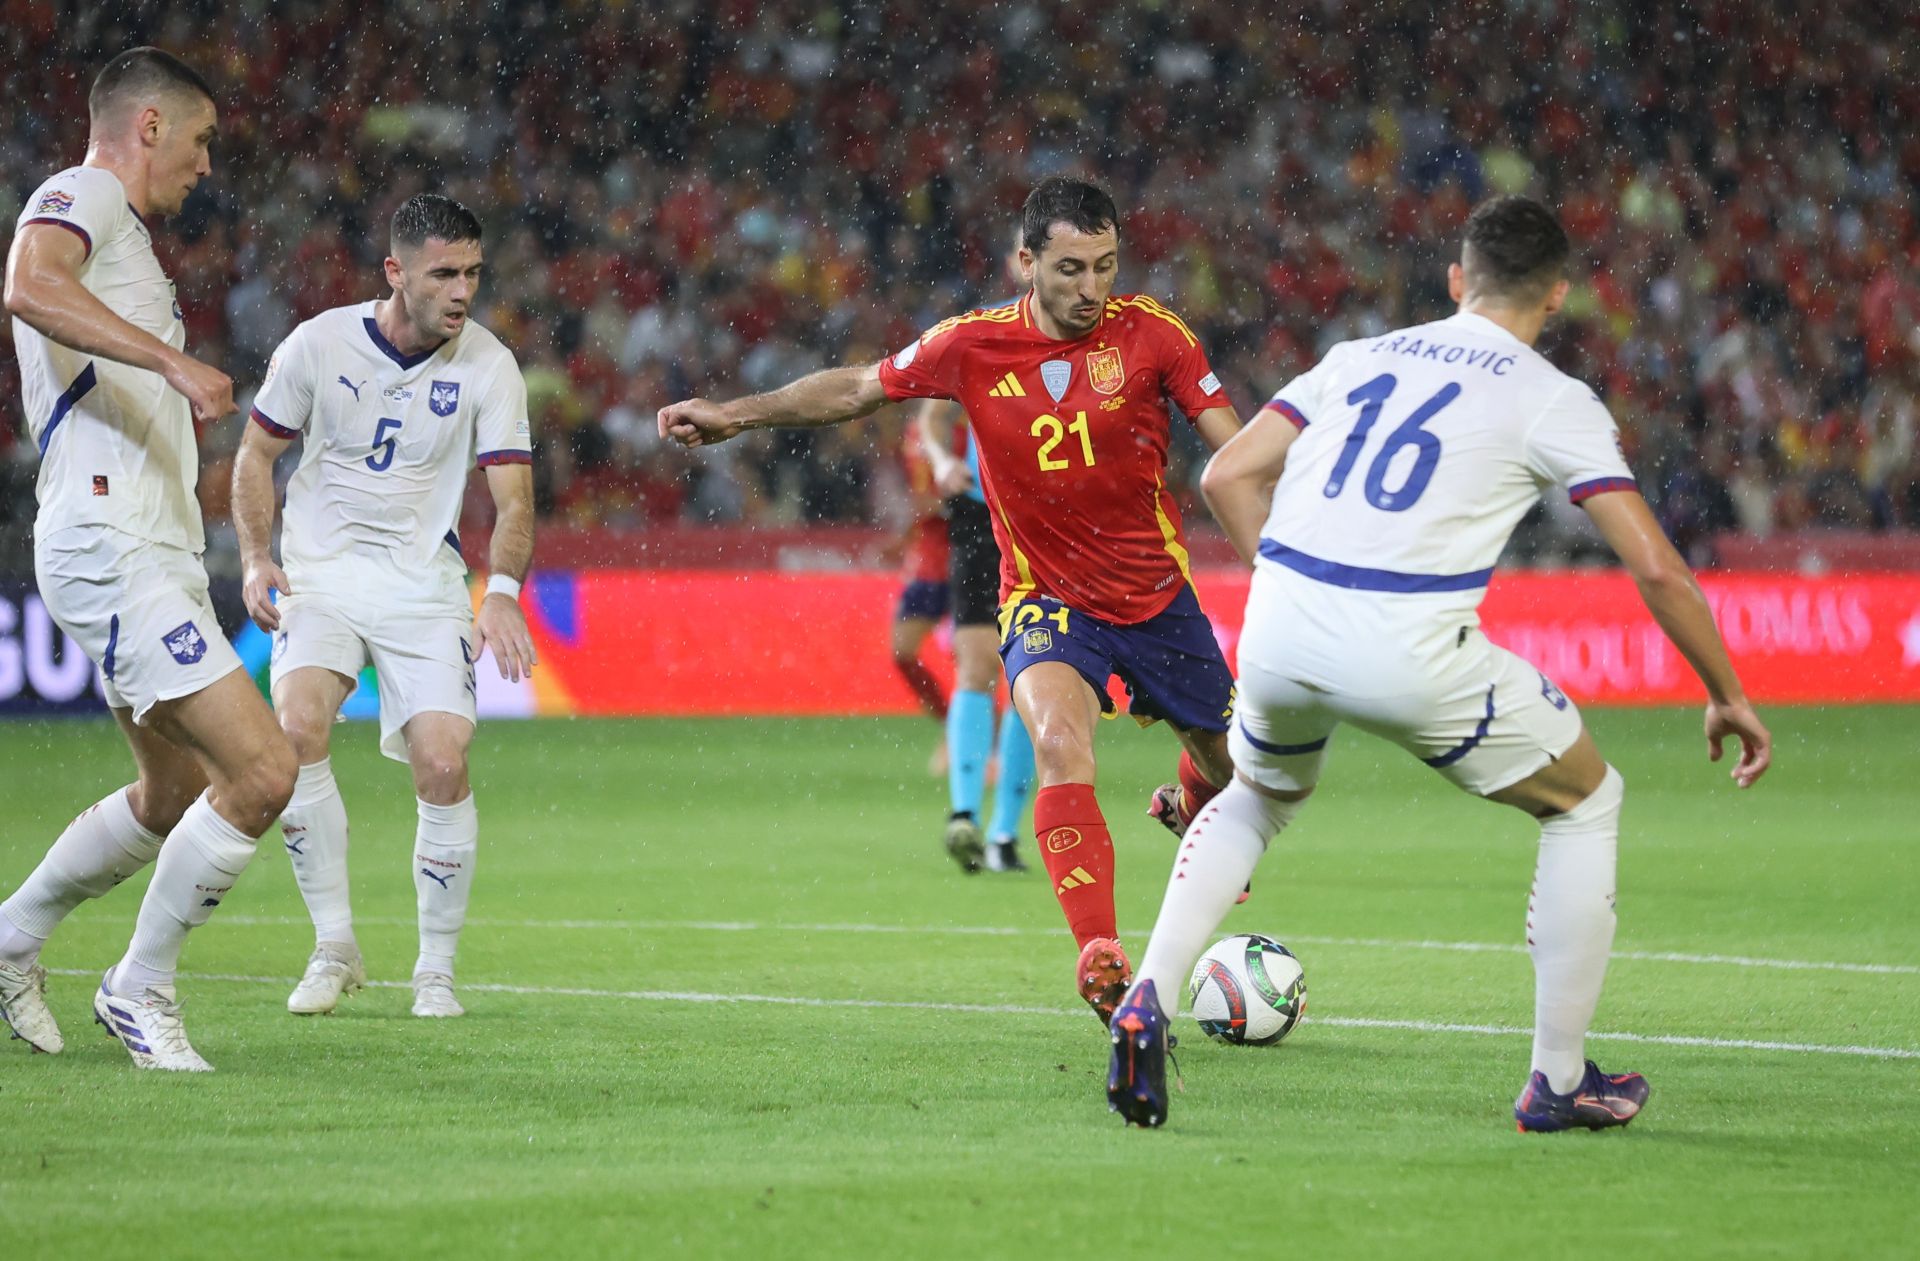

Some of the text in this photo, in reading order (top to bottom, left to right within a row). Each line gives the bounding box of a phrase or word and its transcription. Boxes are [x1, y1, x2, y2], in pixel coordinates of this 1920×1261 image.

[365, 417, 402, 472] 5
[1030, 410, 1096, 472] 21
[1323, 373, 1462, 512] 16
